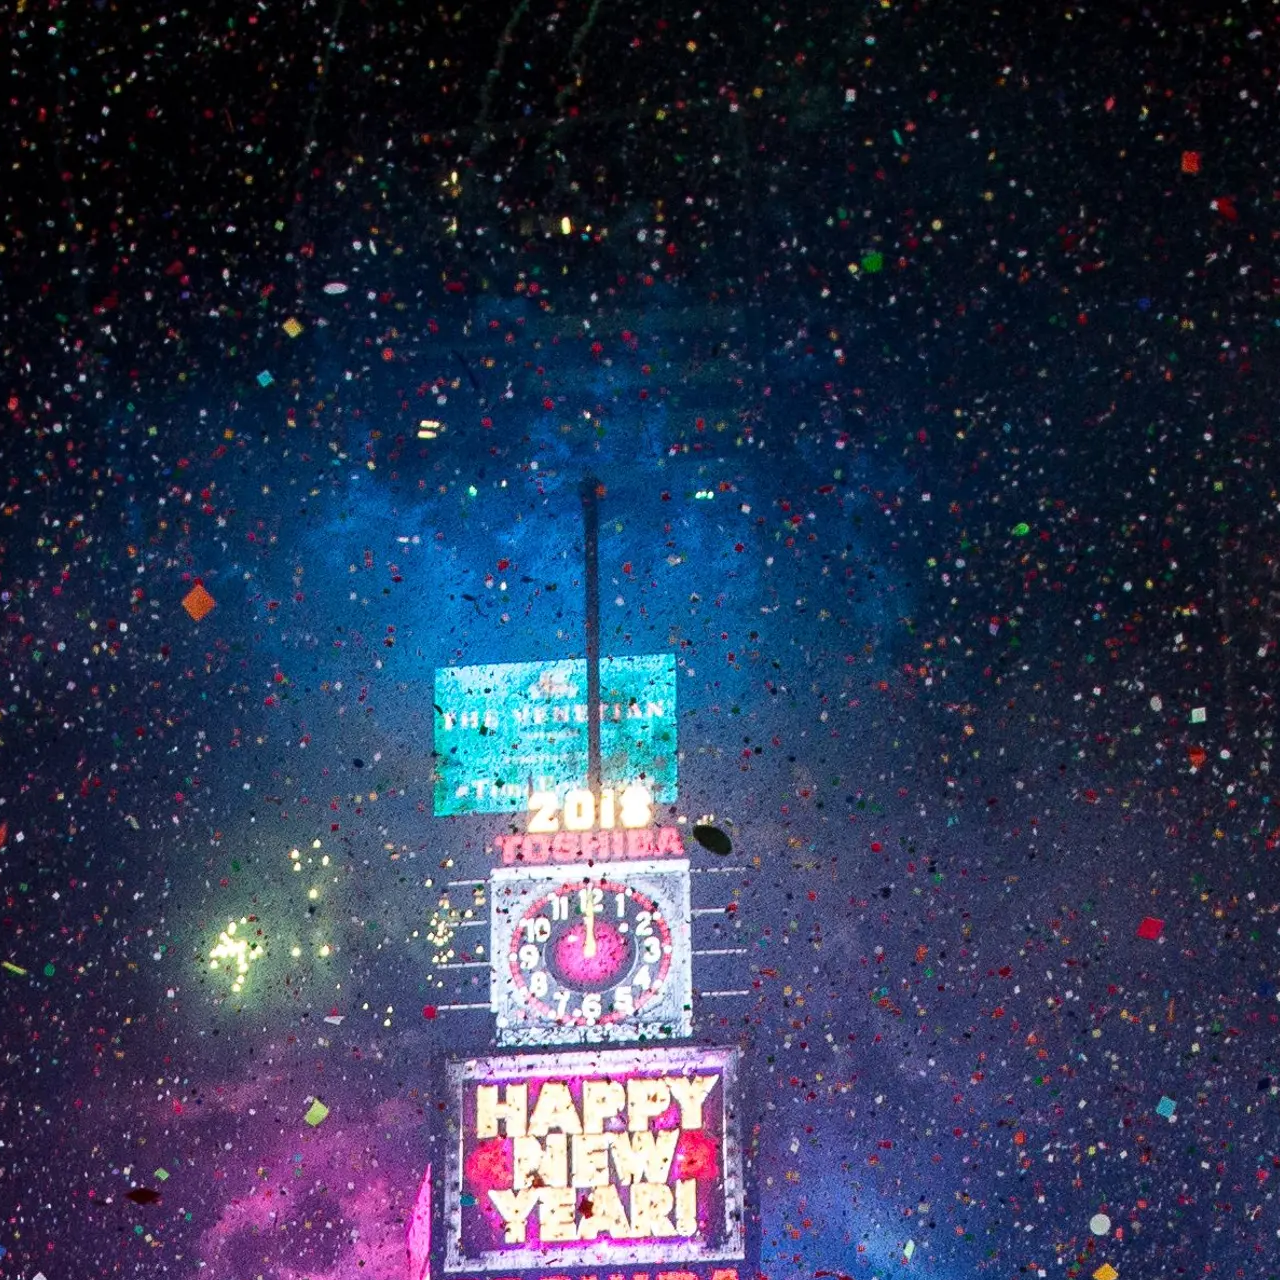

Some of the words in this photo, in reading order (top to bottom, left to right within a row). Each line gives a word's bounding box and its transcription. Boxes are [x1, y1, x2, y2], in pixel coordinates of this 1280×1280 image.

[527, 789, 652, 834] 2018
[495, 826, 685, 866] TOSHIBA
[551, 896, 569, 921] 11
[578, 888, 604, 914] 12
[615, 892, 626, 918] 1
[522, 917, 551, 943] 10
[635, 911, 654, 936] 2
[519, 944, 540, 970] 9
[642, 936, 661, 964] 3
[529, 971, 548, 998] 8
[633, 965, 652, 990] 4
[553, 990, 570, 1016] 7
[581, 993, 602, 1019] 6
[614, 986, 634, 1014] 5
[476, 1074, 719, 1139] HAPPY
[512, 1128, 680, 1189] NEW
[487, 1177, 699, 1244] YEAR!
